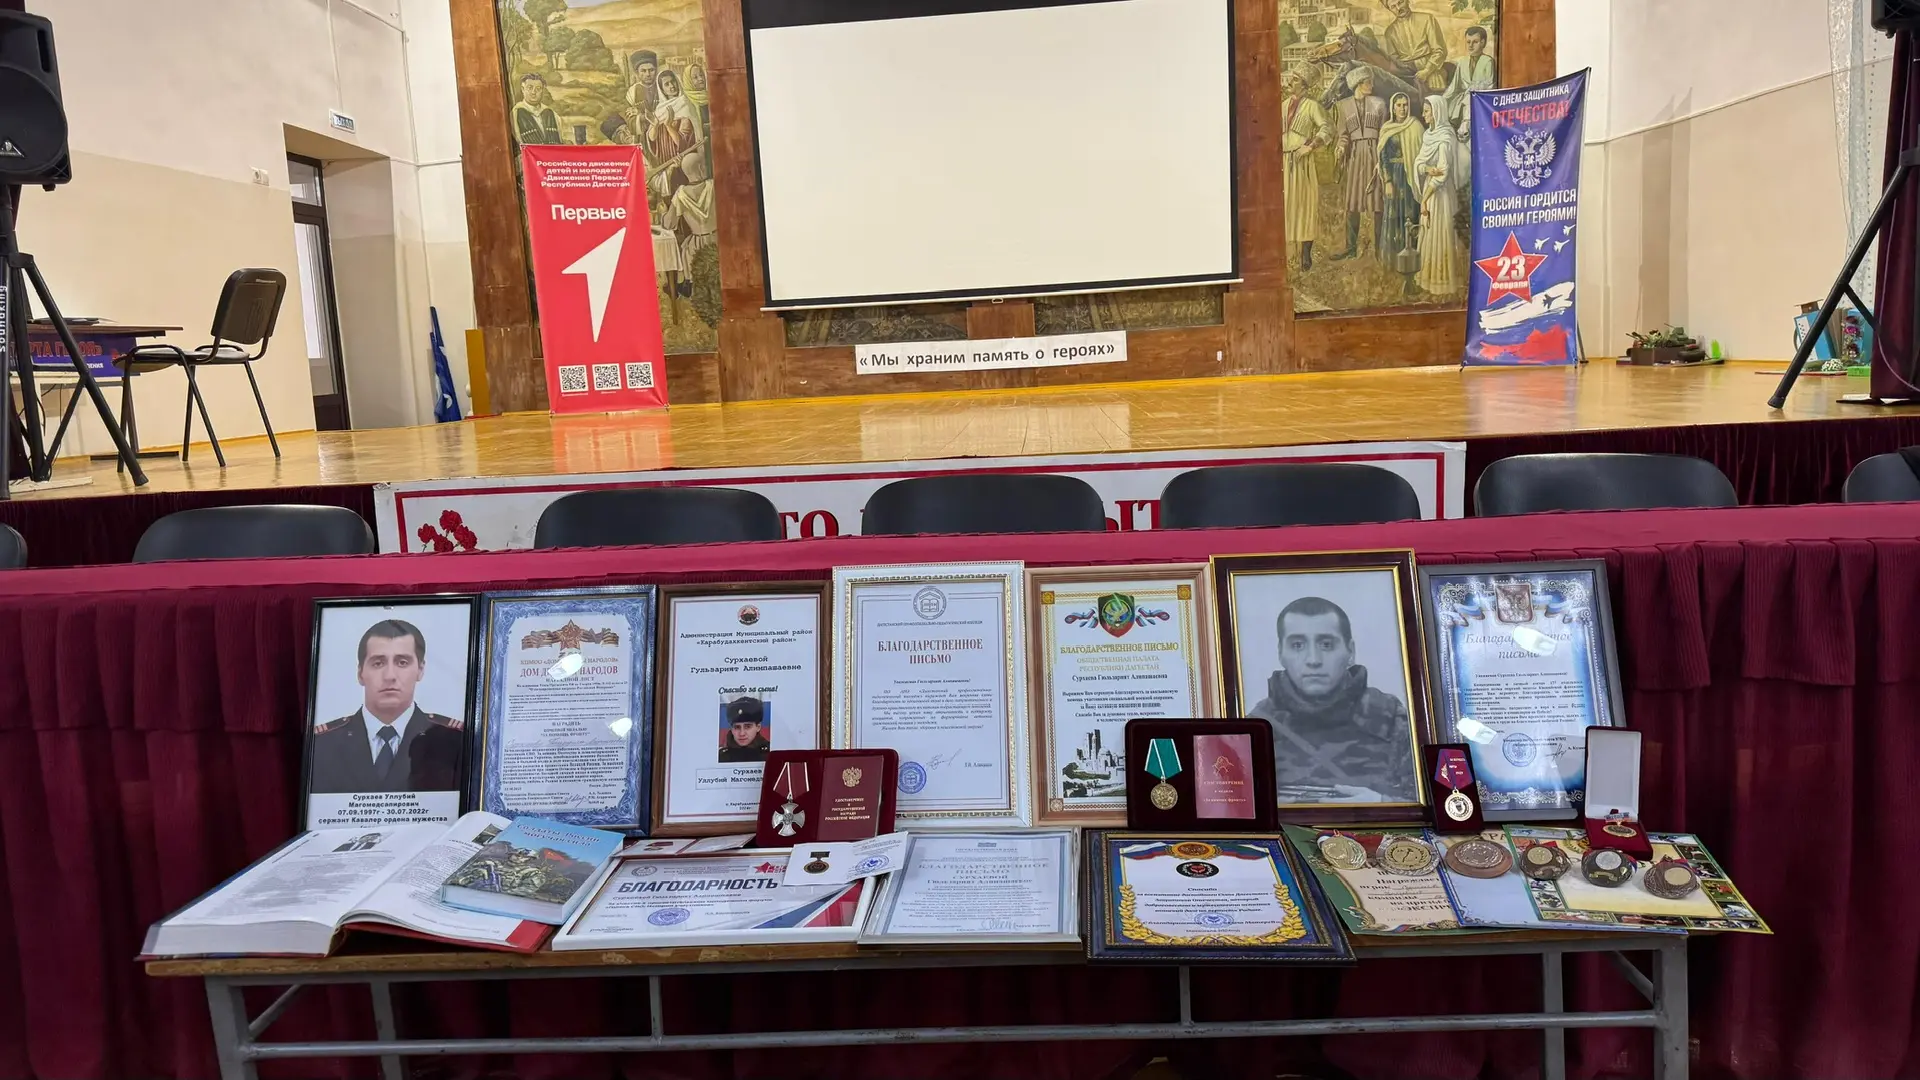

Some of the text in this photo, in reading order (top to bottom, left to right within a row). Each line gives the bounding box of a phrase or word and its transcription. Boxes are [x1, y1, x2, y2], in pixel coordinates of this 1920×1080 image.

[1492, 96, 1499, 107] С
[1523, 84, 1570, 102] ЗАЩИТНИКА
[1491, 100, 1570, 129] ОТЕЧЕСТВА!
[536, 160, 630, 168] Российское движение
[541, 181, 591, 189] Республики
[1483, 188, 1577, 213] РОССИЯ ГОРДИТСЯ
[551, 204, 627, 225] Первые
[1482, 206, 1577, 229] СВОИМИ ГЕРОЯМИ!
[1496, 254, 1526, 281] 23
[907, 352, 966, 366] храним
[972, 350, 1029, 363] память
[1035, 349, 1045, 360] о
[1053, 344, 1115, 360] героях»
[680, 629, 813, 640] Администрация Муниципальный район
[772, 637, 797, 645] район»
[878, 638, 983, 653] БЛАГОДАРСТВЕННОЕ
[1060, 641, 1179, 654] БЛАГОДАРСТВЕННОЕ ПИСЬМО
[724, 655, 769, 665] Сурхаевой
[910, 653, 951, 665] ПИСЬМО
[520, 668, 539, 678] ДОМ
[580, 665, 618, 676] НАРОДОВ
[1072, 674, 1097, 683] Сурхаева
[718, 685, 747, 695] Спасибо
[757, 685, 778, 693] сына!
[352, 793, 416, 801] Сурхаев Уллубий
[348, 801, 419, 809] Магомедсапирович
[386, 808, 430, 816] 30.07.2022г
[318, 815, 448, 825] сержант Кавалер ордена мужества
[617, 877, 778, 893] БЛАГОДАРНОСТЬ
